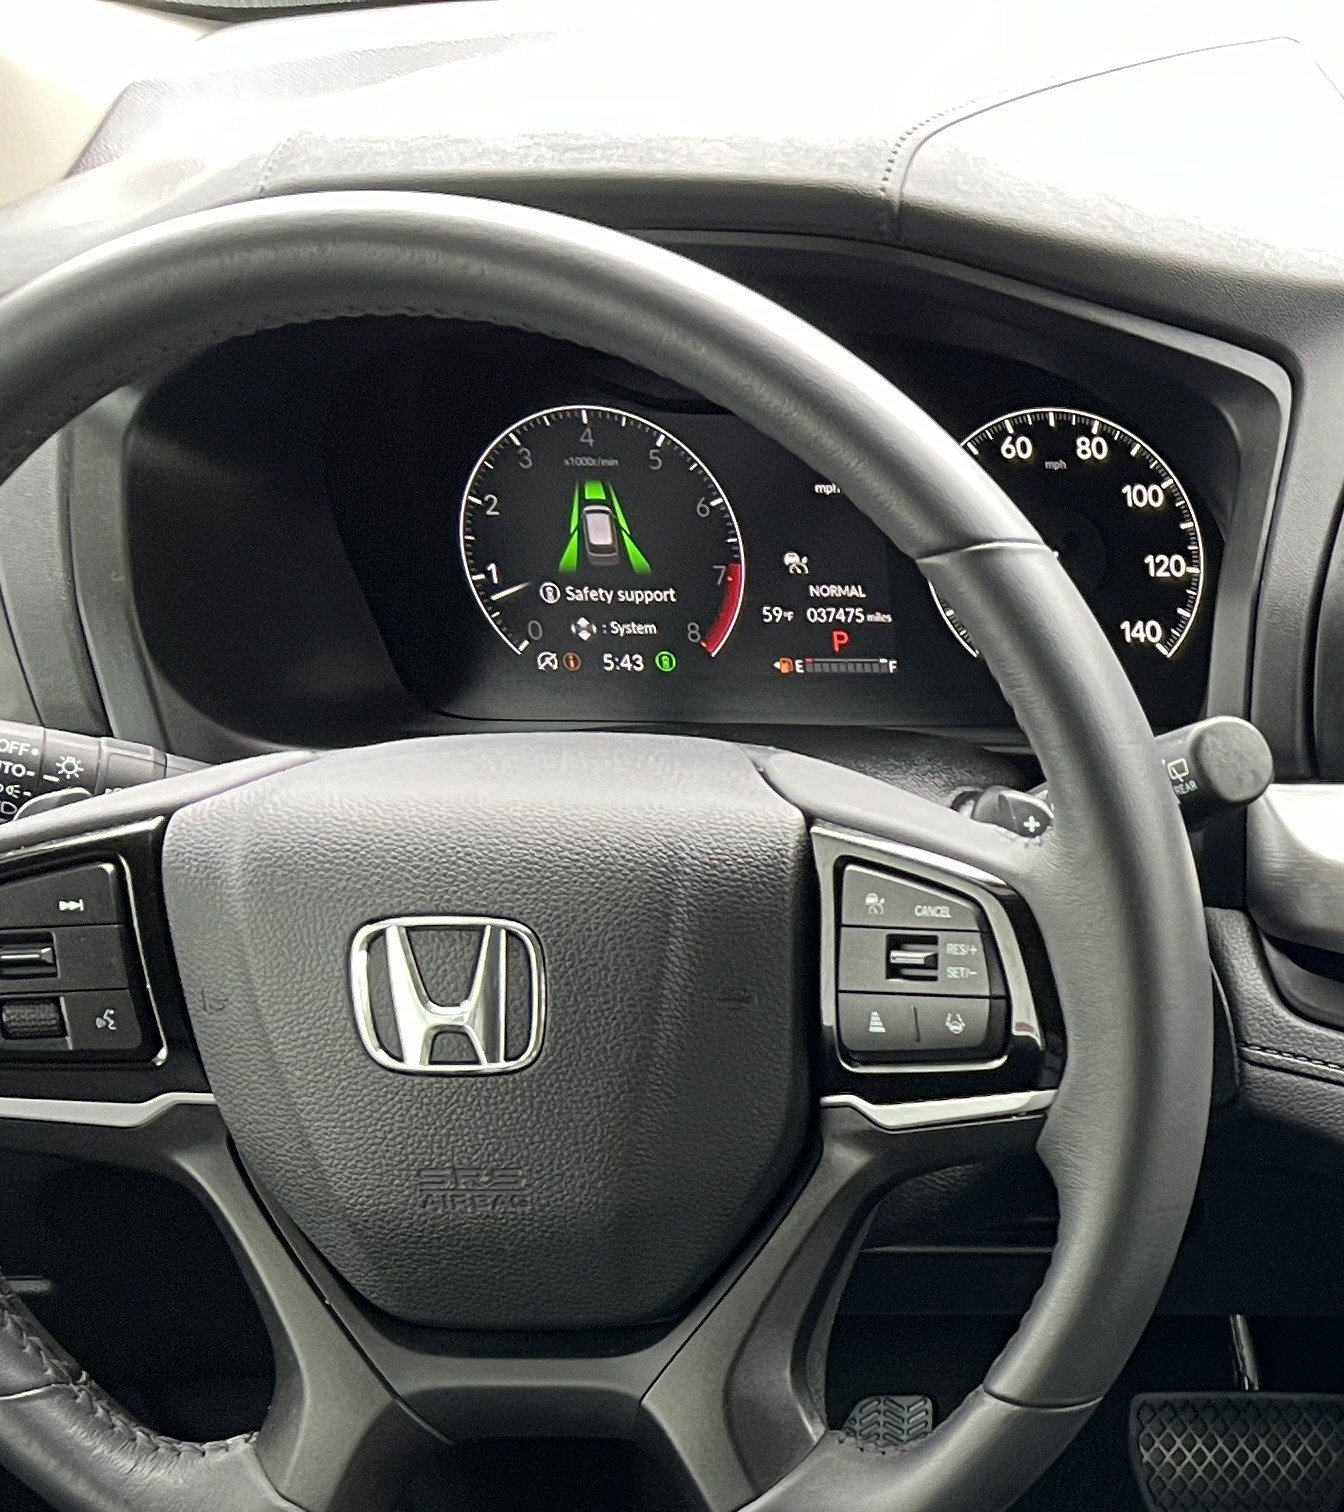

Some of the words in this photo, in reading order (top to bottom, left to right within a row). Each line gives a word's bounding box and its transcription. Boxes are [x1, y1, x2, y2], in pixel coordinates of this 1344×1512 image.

[580, 427, 594, 448] 4
[517, 448, 534, 470] 3
[1000, 437, 1033, 461] 60
[1075, 437, 1109, 461] 80
[647, 448, 664, 471] 5
[1044, 459, 1068, 471] mph
[484, 494, 501, 518] 2
[1121, 484, 1165, 509] 100
[696, 499, 711, 519] 6
[1143, 554, 1187, 579] 120
[564, 586, 614, 604] Safety
[616, 586, 677, 604] support
[808, 584, 867, 598] NORMAL
[805, 606, 866, 623] 037475
[526, 620, 544, 641] 0
[609, 620, 658, 638] System
[1119, 620, 1163, 645] 140
[832, 630, 850, 653] P
[602, 654, 645, 672] 5:43
[795, 659, 805, 673] E
[888, 660, 898, 674] F
[1174, 780, 1199, 796] REAR
[914, 905, 953, 918] CANCEL
